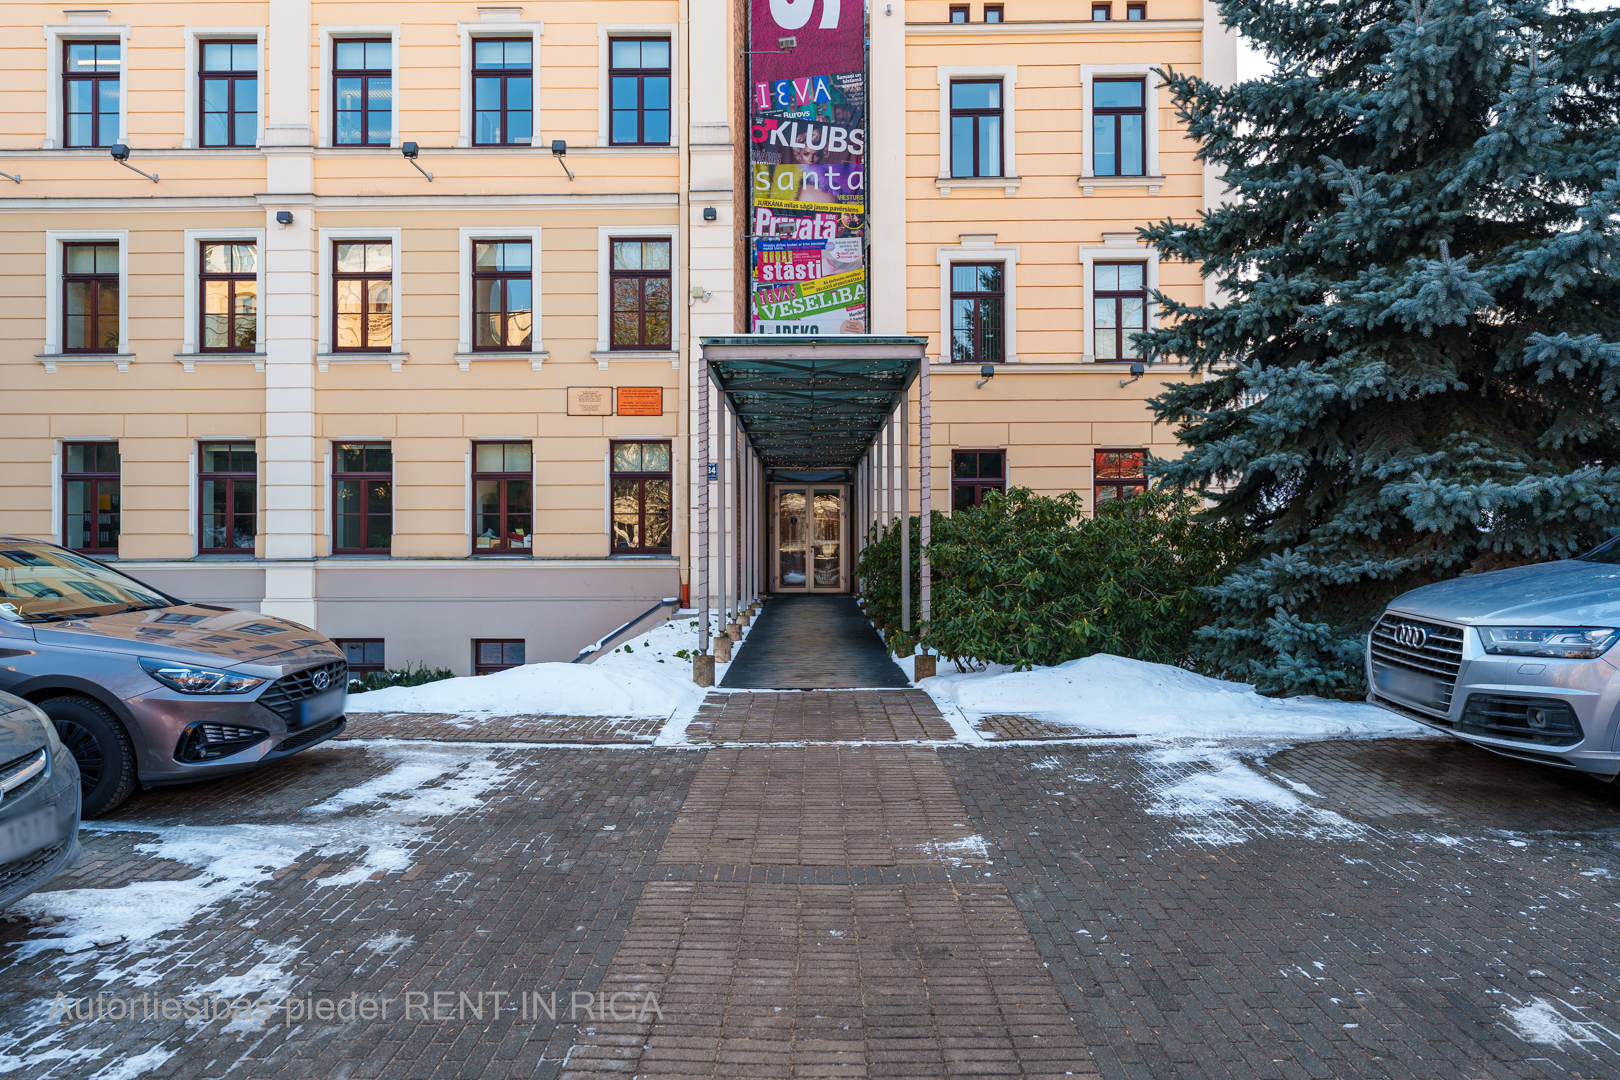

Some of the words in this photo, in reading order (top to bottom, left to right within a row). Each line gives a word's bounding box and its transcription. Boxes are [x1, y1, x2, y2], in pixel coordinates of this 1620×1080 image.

[758, 78, 832, 108] IEVA
[783, 110, 810, 118] Burovs
[770, 120, 864, 155] KLUBS
[756, 166, 864, 190] santa
[763, 260, 821, 280] stāsti
[760, 288, 796, 305] IEVAS
[761, 284, 865, 319] VESELĪBA
